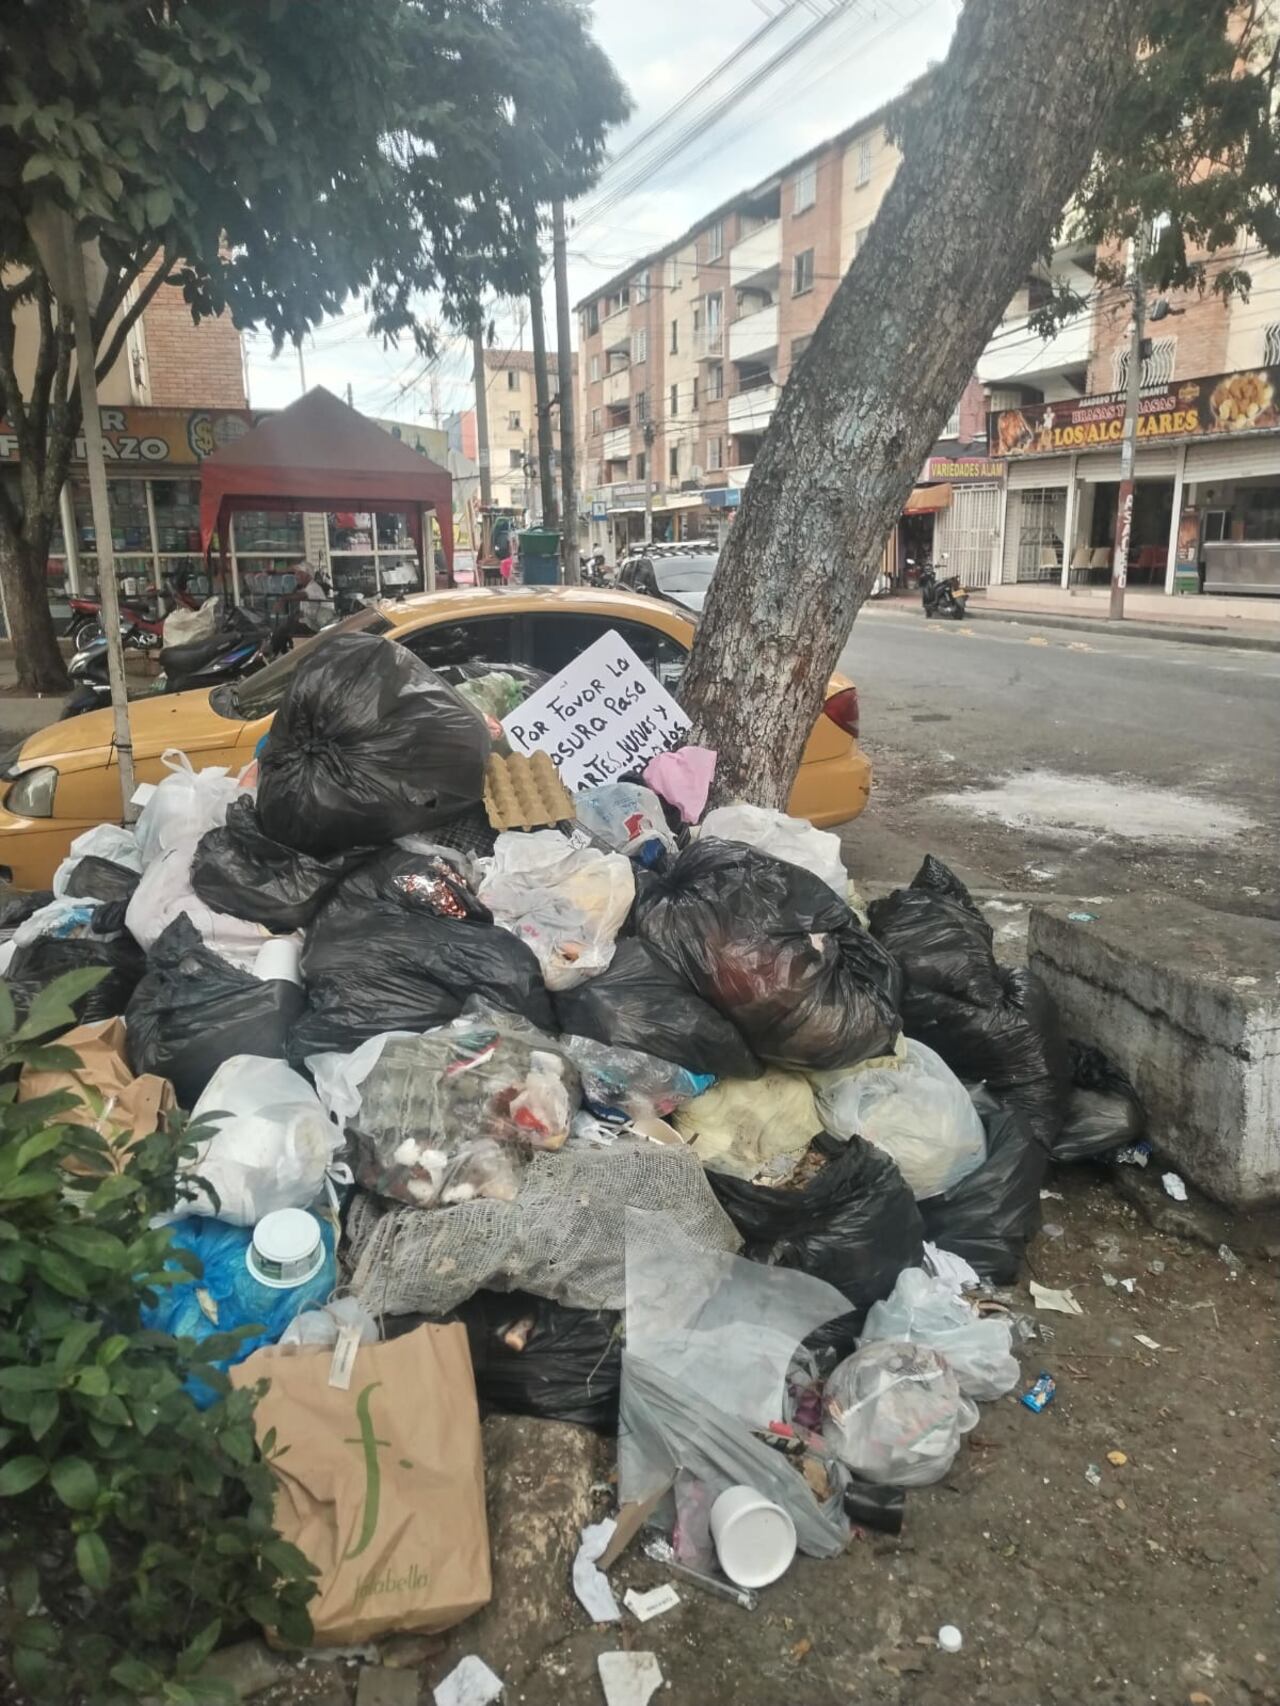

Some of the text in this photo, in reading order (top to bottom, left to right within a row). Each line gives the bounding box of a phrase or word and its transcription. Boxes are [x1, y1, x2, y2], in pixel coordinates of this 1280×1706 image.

[1054, 409, 1199, 446] LOS ALCZARES
[931, 463, 979, 477] VARIEDADES
